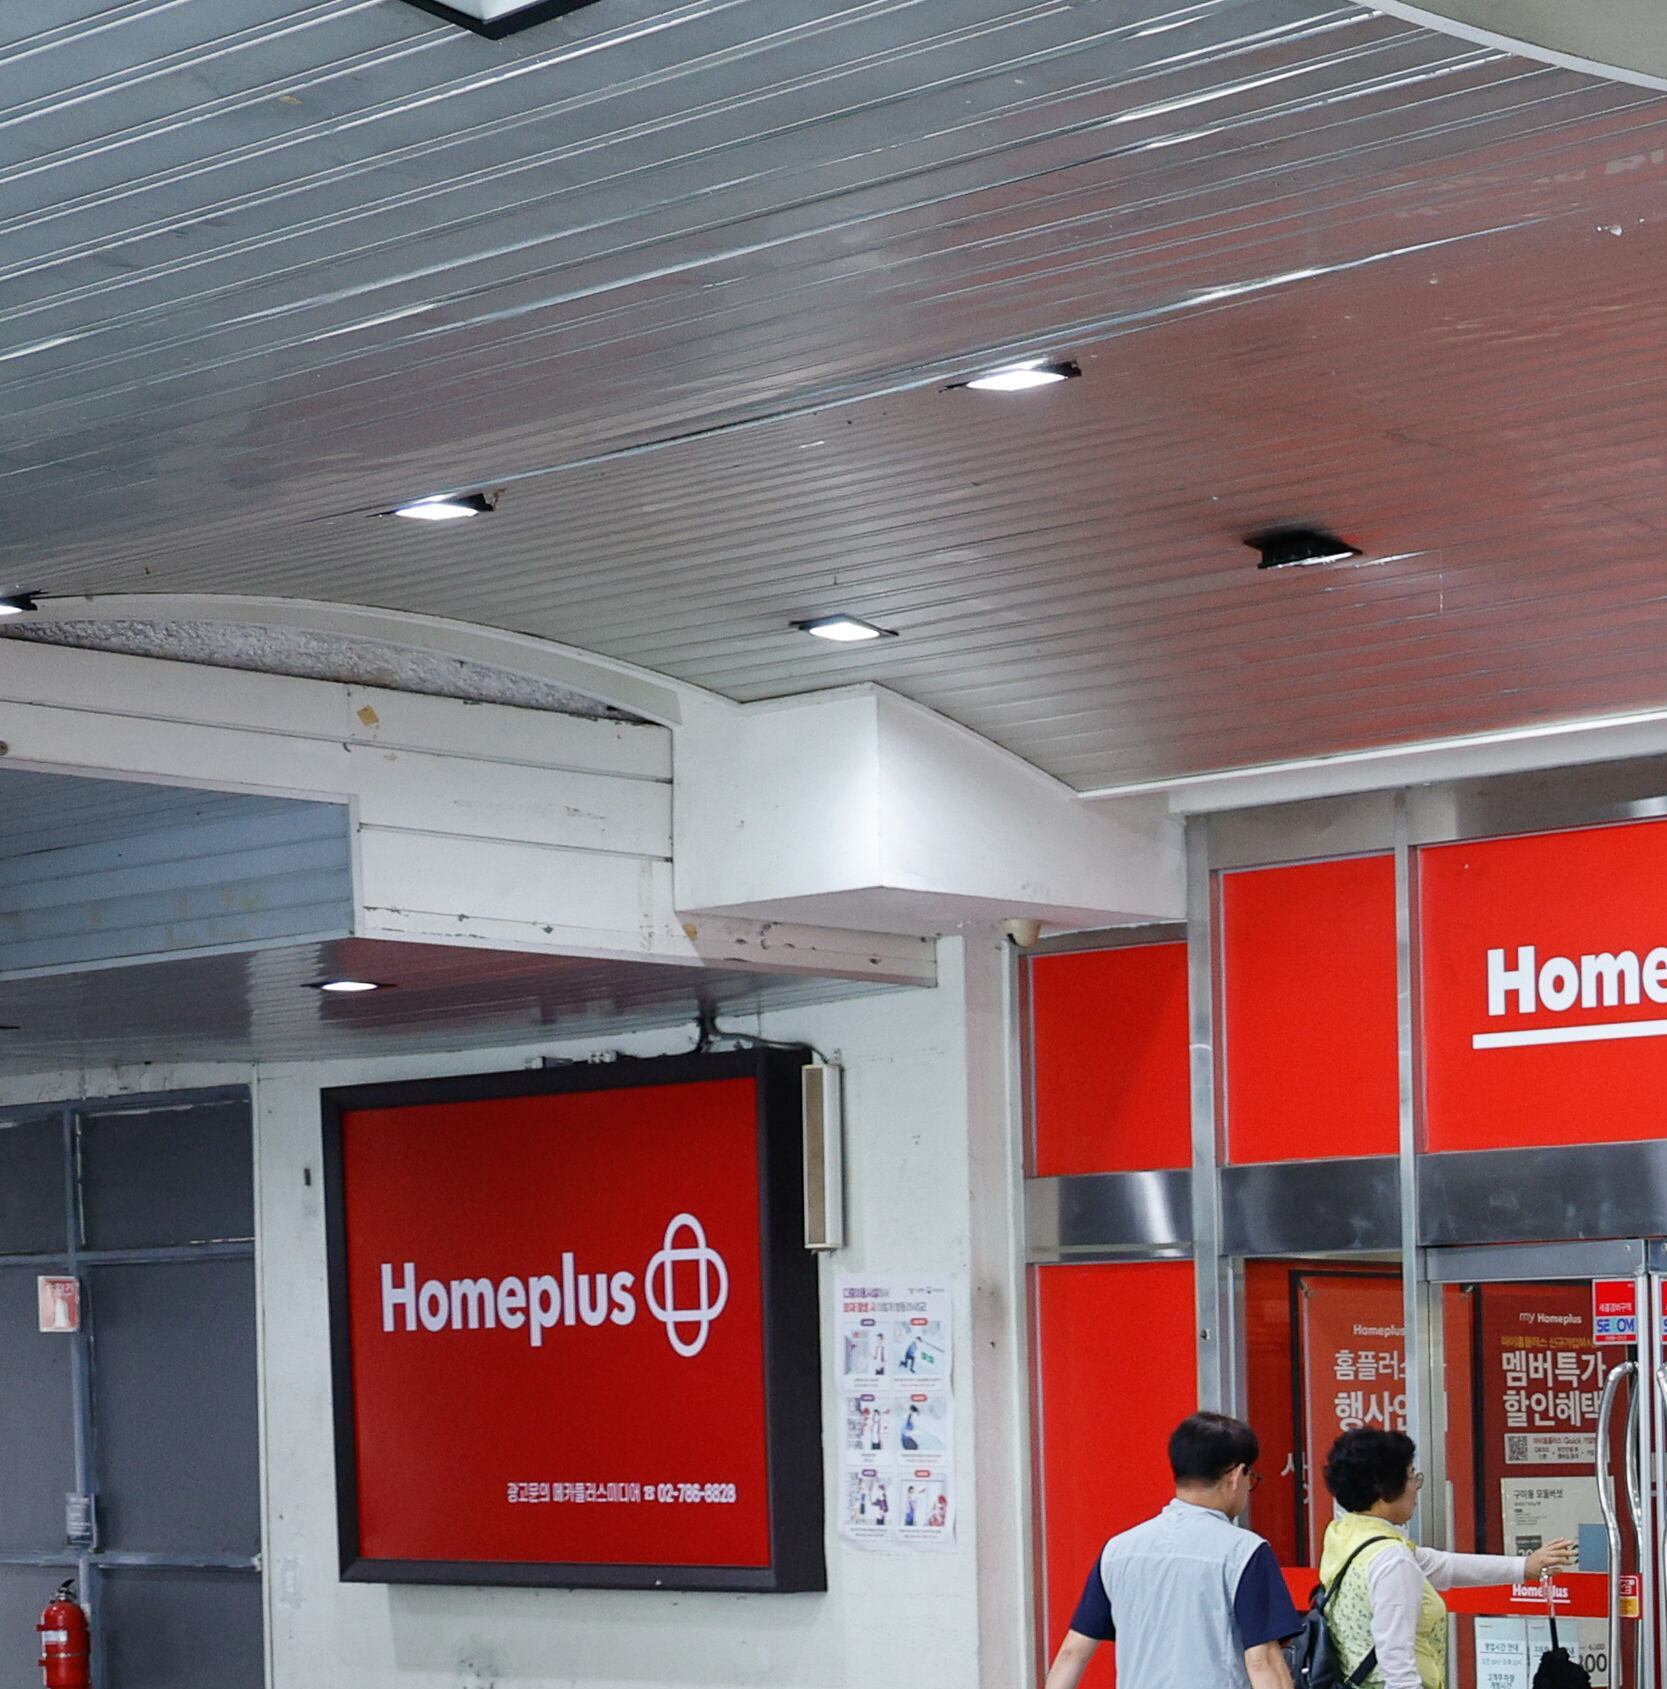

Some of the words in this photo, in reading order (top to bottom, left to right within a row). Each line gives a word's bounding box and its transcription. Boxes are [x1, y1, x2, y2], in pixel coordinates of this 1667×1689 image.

[380, 1252, 636, 1347] Homeplus
[1519, 1312, 1535, 1324] my
[1537, 1313, 1582, 1326] Homeplus
[1501, 1350, 1606, 1388] 멤버특가
[1503, 1389, 1602, 1427] 할인혜택
